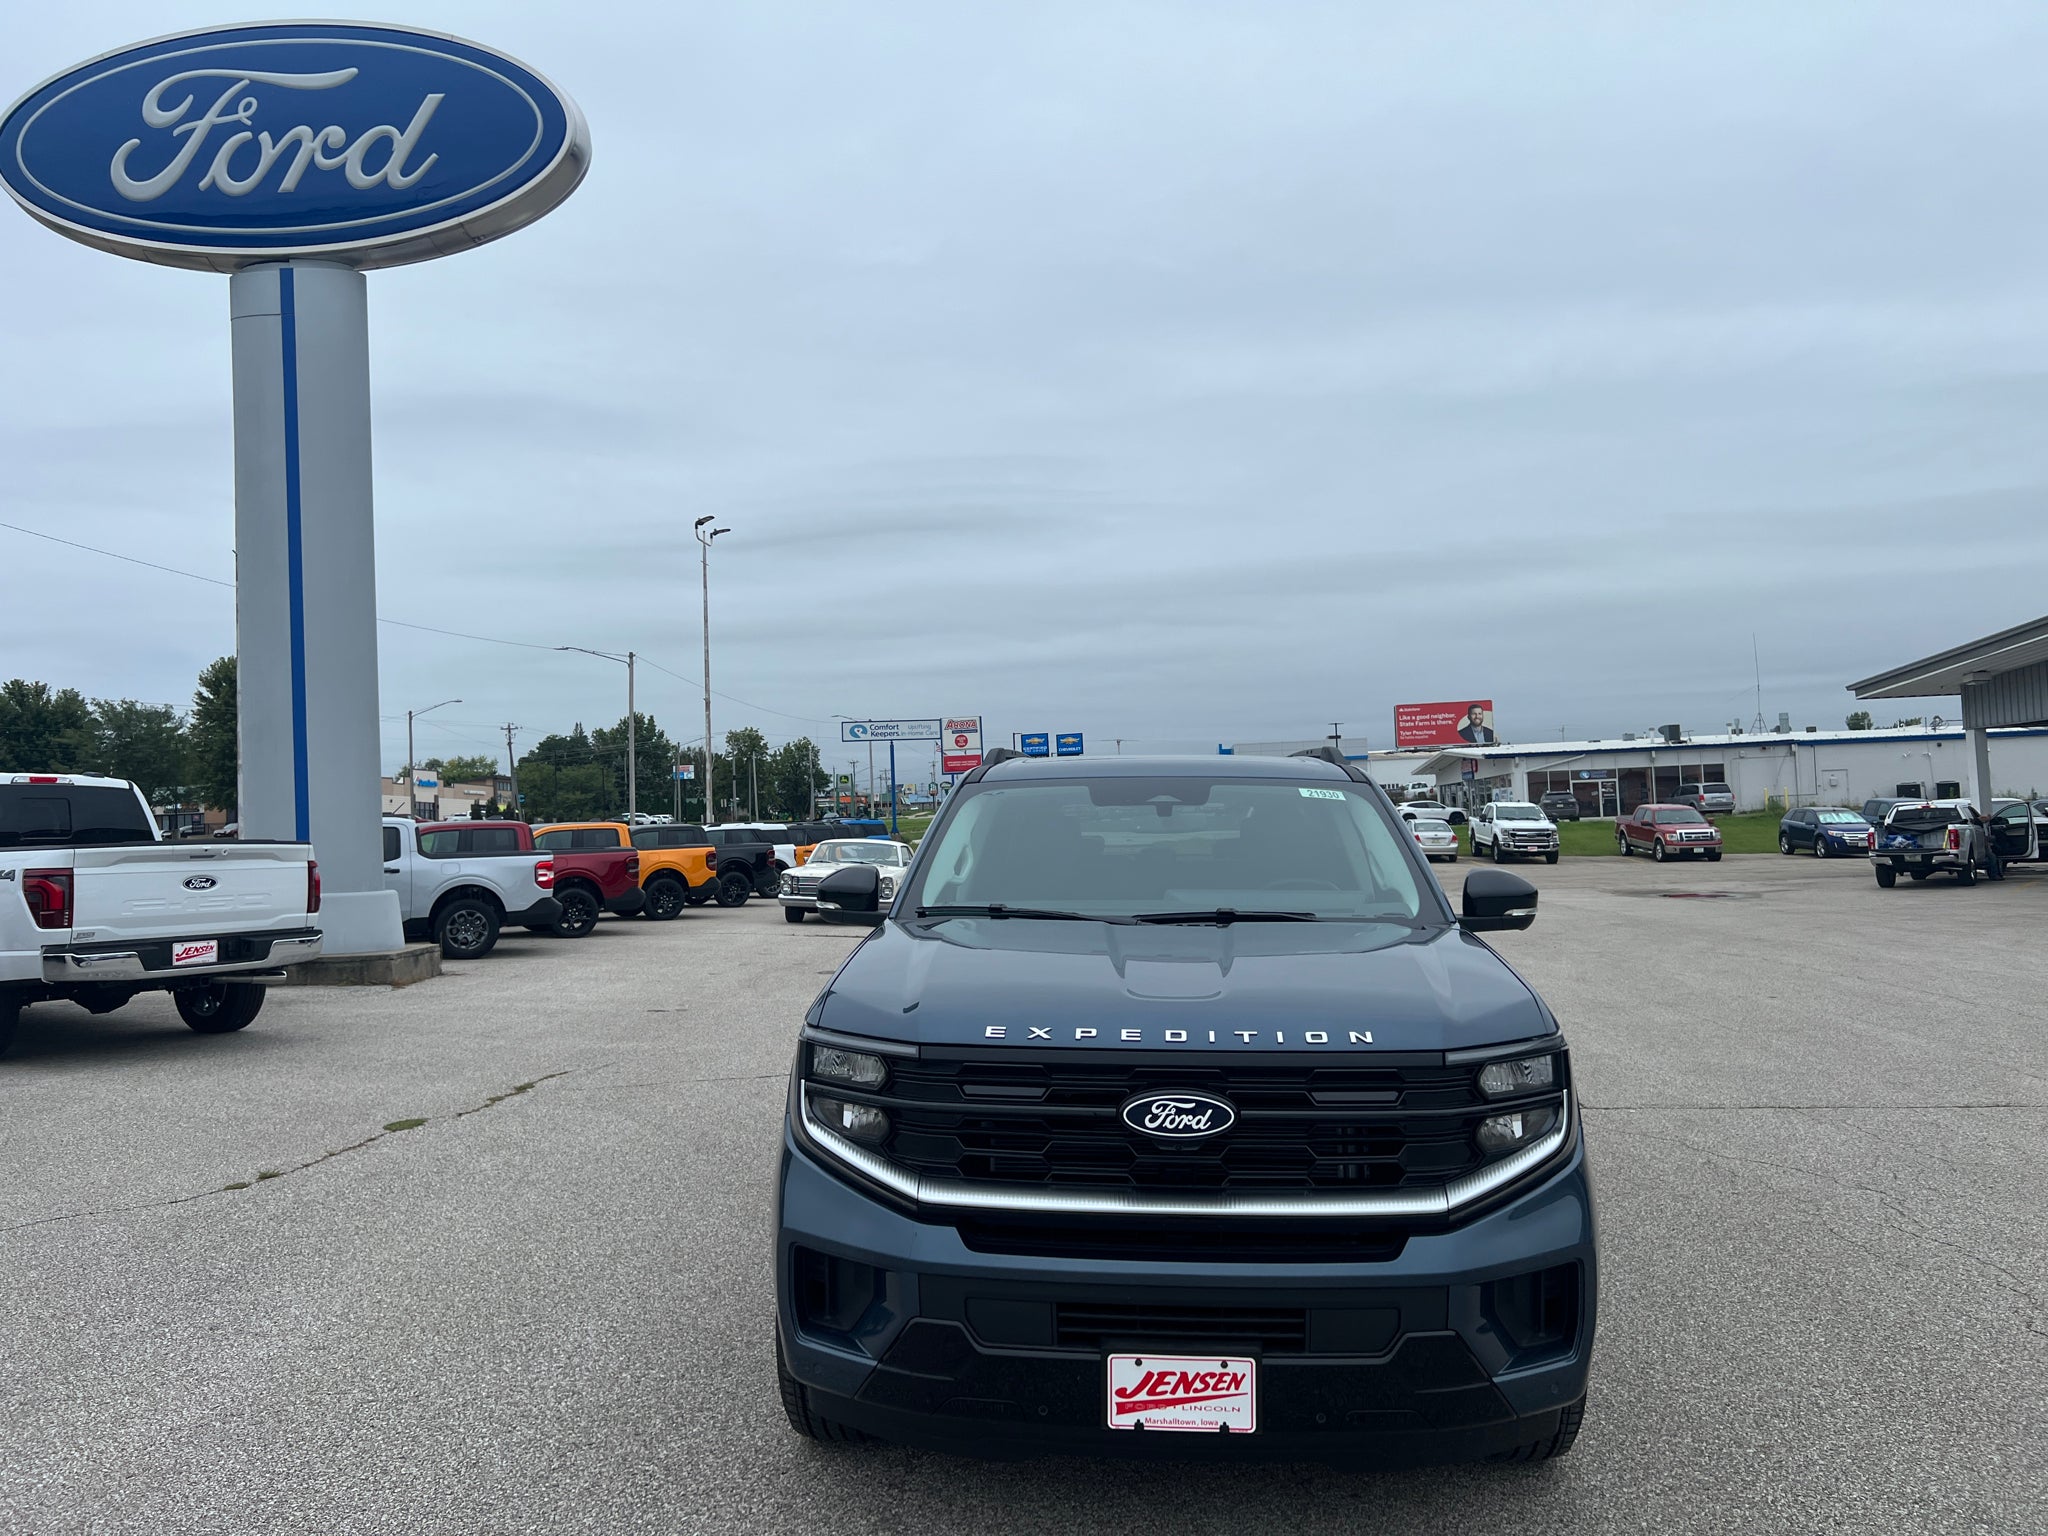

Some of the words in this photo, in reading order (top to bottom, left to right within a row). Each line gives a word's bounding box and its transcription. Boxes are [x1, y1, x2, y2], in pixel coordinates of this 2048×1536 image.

[110, 67, 446, 201] Ford
[869, 723, 900, 731] Comfort
[907, 723, 931, 731] Uplifting
[870, 730, 900, 738] Keepers
[1307, 790, 1340, 798] 21930
[189, 878, 212, 888] Ford
[175, 944, 215, 957] JENSEN
[984, 1025, 1374, 1044] EXPEDITION
[1144, 1100, 1213, 1130] Ford
[1114, 1370, 1246, 1399] JENSEN
[1181, 1404, 1241, 1413] LINCOLN
[1200, 1417, 1219, 1427] Iowa
